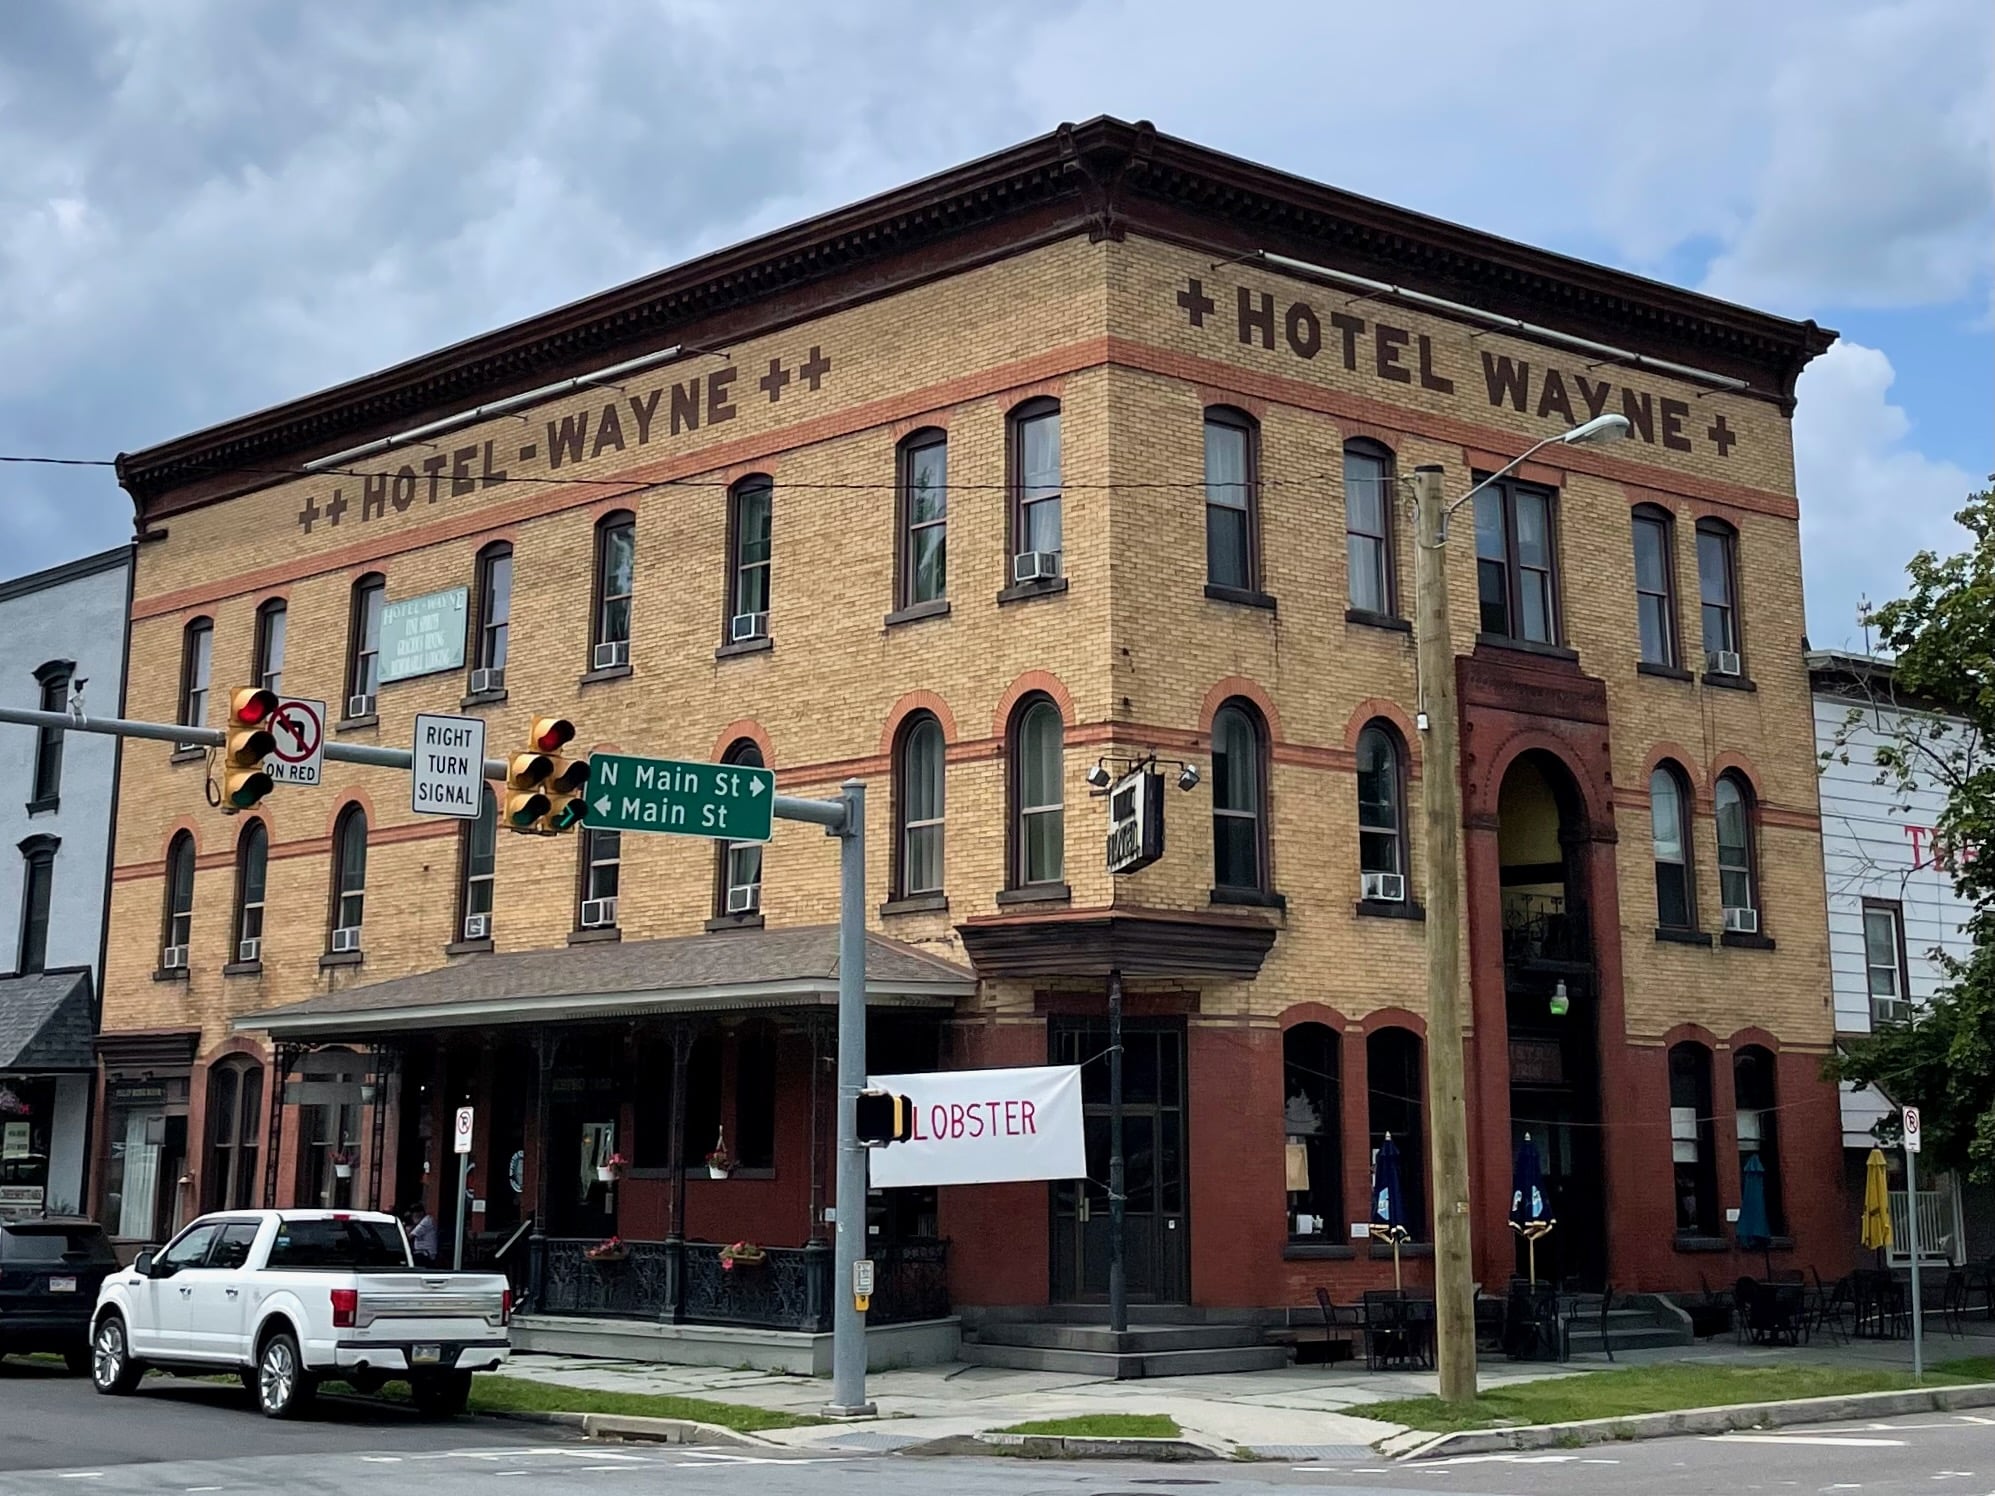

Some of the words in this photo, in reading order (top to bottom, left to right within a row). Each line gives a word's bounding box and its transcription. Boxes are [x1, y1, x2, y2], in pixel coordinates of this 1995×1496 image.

[1237, 286, 1454, 395] HOTEL
[1480, 351, 1692, 453] WAYNE
[426, 726, 473, 748] RIGHT
[266, 763, 284, 778] ON
[290, 765, 315, 780] RED
[428, 754, 468, 776] TURN
[600, 761, 618, 786] N
[635, 765, 698, 793] Main
[714, 773, 740, 797] St
[418, 782, 474, 805] SIGNAL
[621, 797, 685, 824] Main
[701, 804, 728, 828] St
[913, 1100, 1037, 1140] LOBSTER
